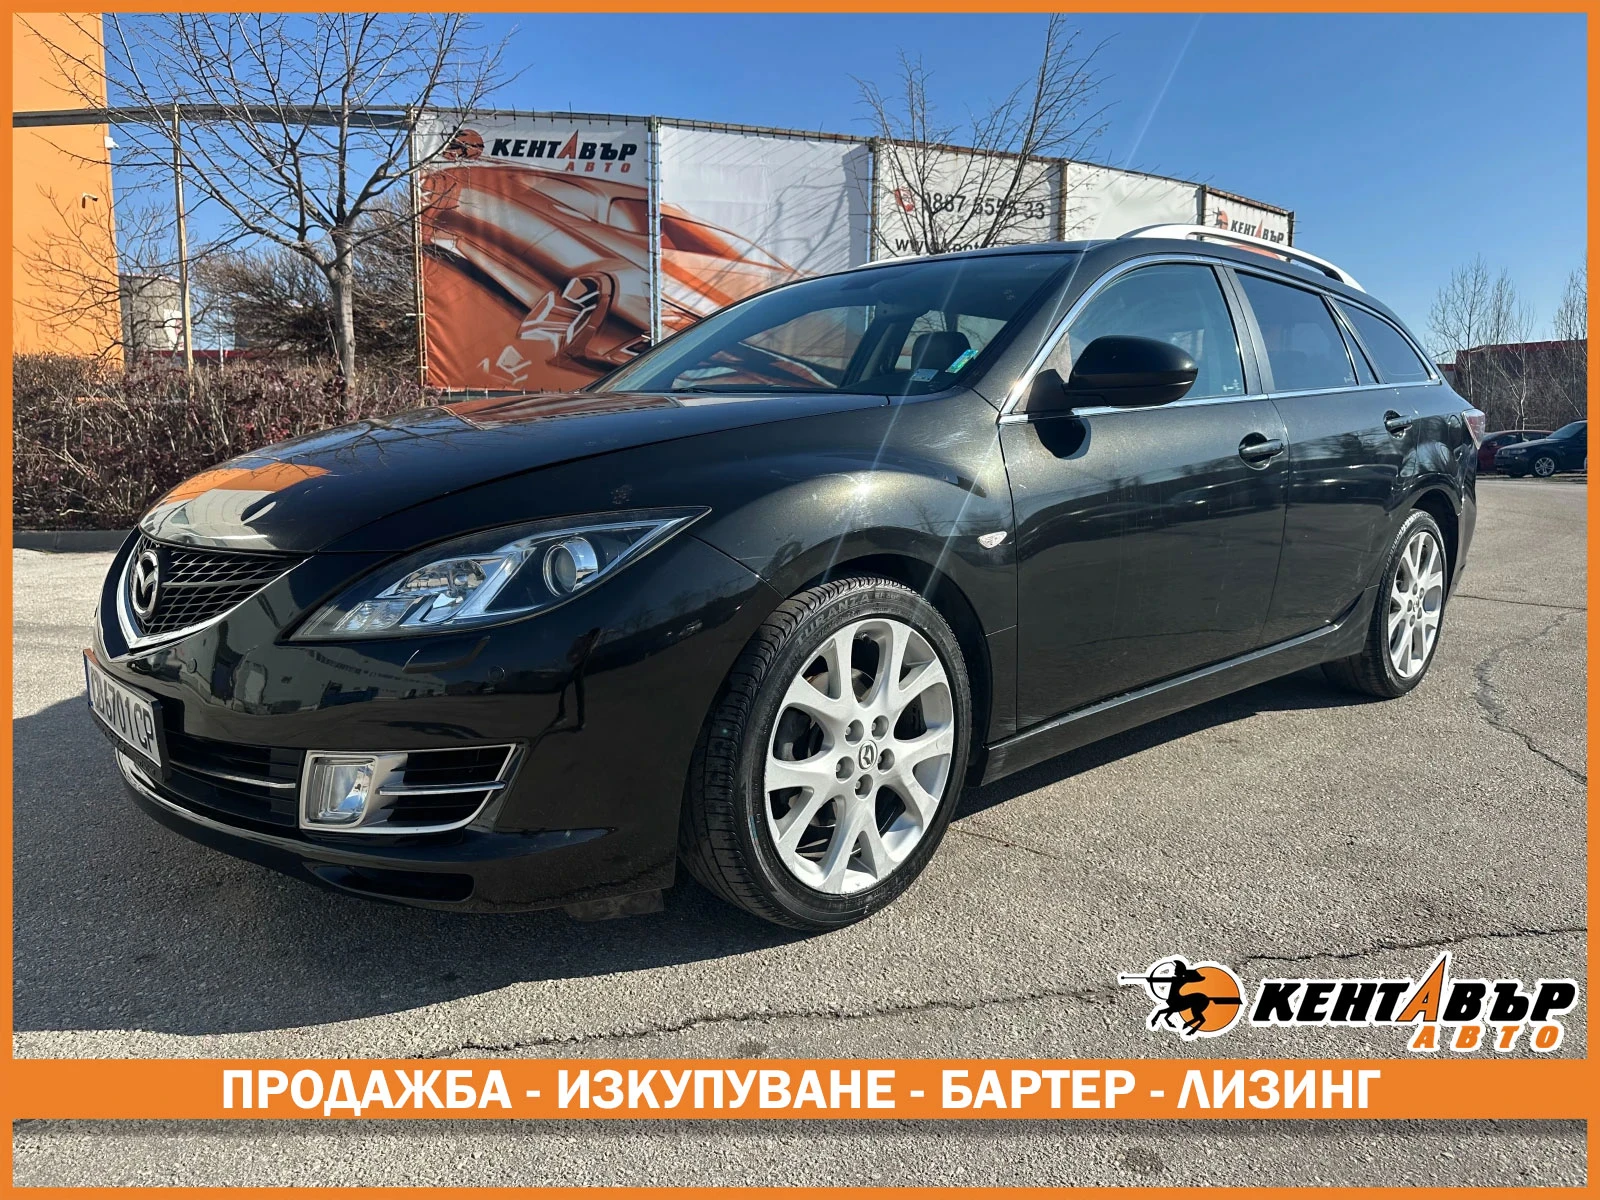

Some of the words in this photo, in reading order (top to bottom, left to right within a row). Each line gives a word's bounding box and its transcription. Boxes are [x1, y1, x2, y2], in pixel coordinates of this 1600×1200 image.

[491, 129, 638, 161] КЕНТАВЪР
[565, 161, 631, 173] АВТО
[1231, 219, 1285, 244] КЕНТАВЪР
[795, 593, 869, 646] TURANZA
